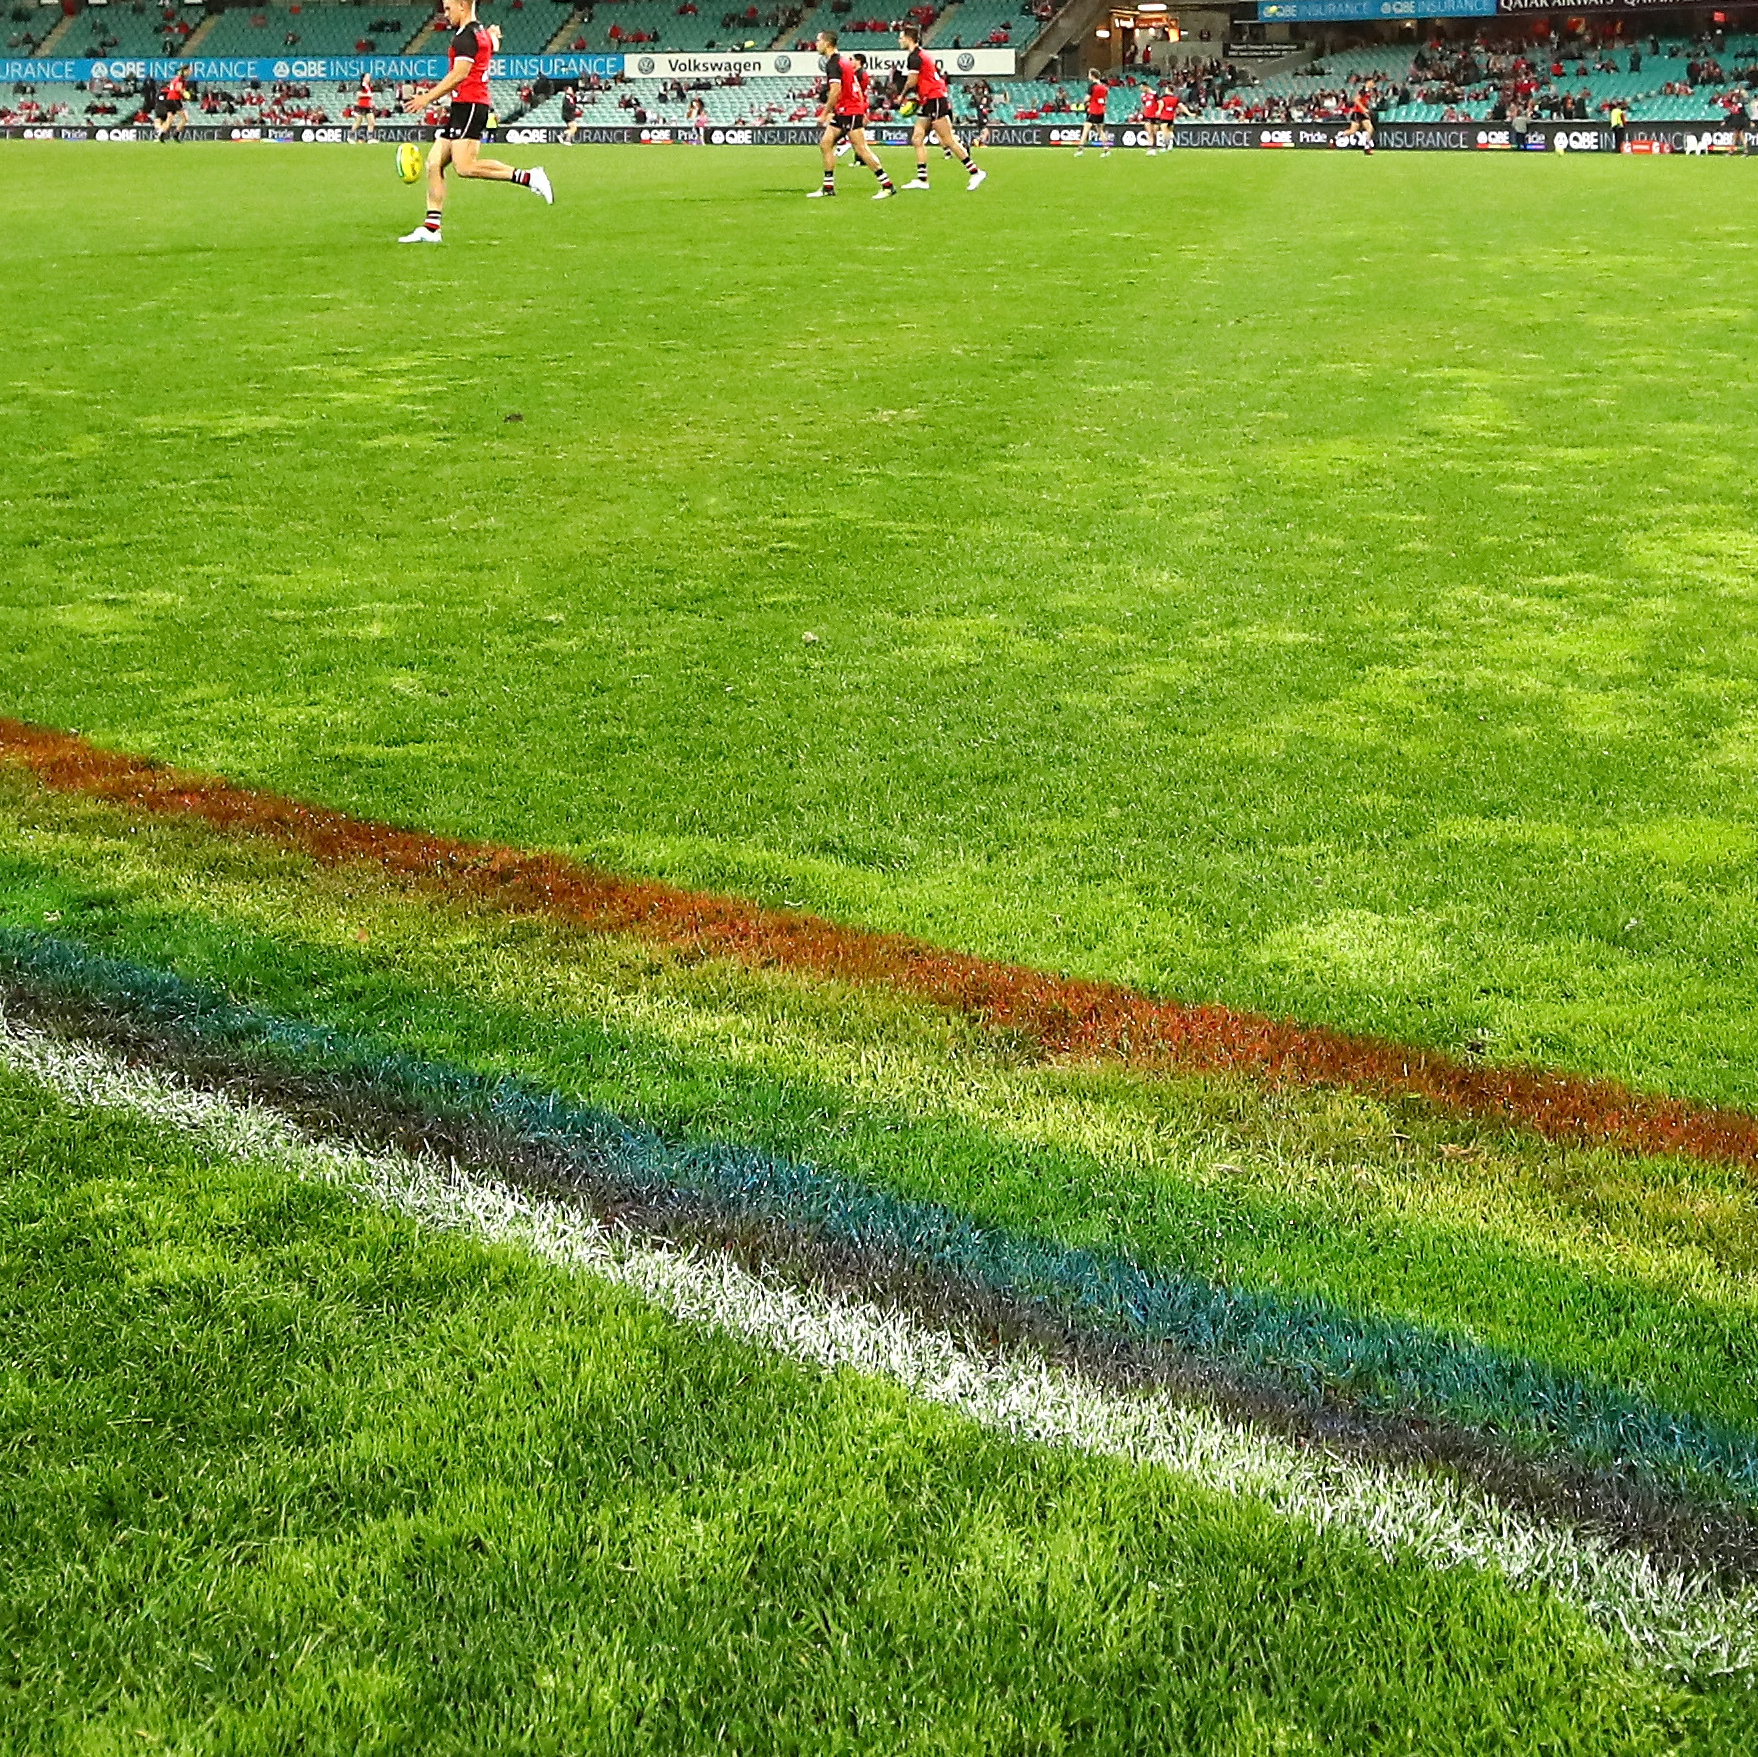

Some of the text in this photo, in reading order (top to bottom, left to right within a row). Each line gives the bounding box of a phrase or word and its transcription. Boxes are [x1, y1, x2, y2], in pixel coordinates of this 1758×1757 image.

[110, 62, 144, 78] QBE
[292, 60, 437, 78] QBE INSURANCE
[489, 57, 617, 75] BE INSURANCE
[668, 58, 761, 76] Volkswagen
[33, 128, 87, 138] QBE Pride
[109, 129, 137, 141] QBE
[242, 128, 295, 140] QBE Pride
[314, 129, 342, 142] QBE
[518, 129, 548, 144] QBE
[651, 129, 671, 140] QBE
[726, 129, 822, 144] QBE INSURAN
[882, 129, 908, 141] Pride
[1062, 130, 1081, 140] QBE
[1173, 130, 1251, 146] NSURANCE
[1272, 130, 1327, 143] QBE Pride
[1379, 131, 1468, 148] INSURANCE
[1488, 131, 1509, 143] QBE
[1713, 132, 1734, 145] QBE
[1569, 132, 1598, 149] QBE
